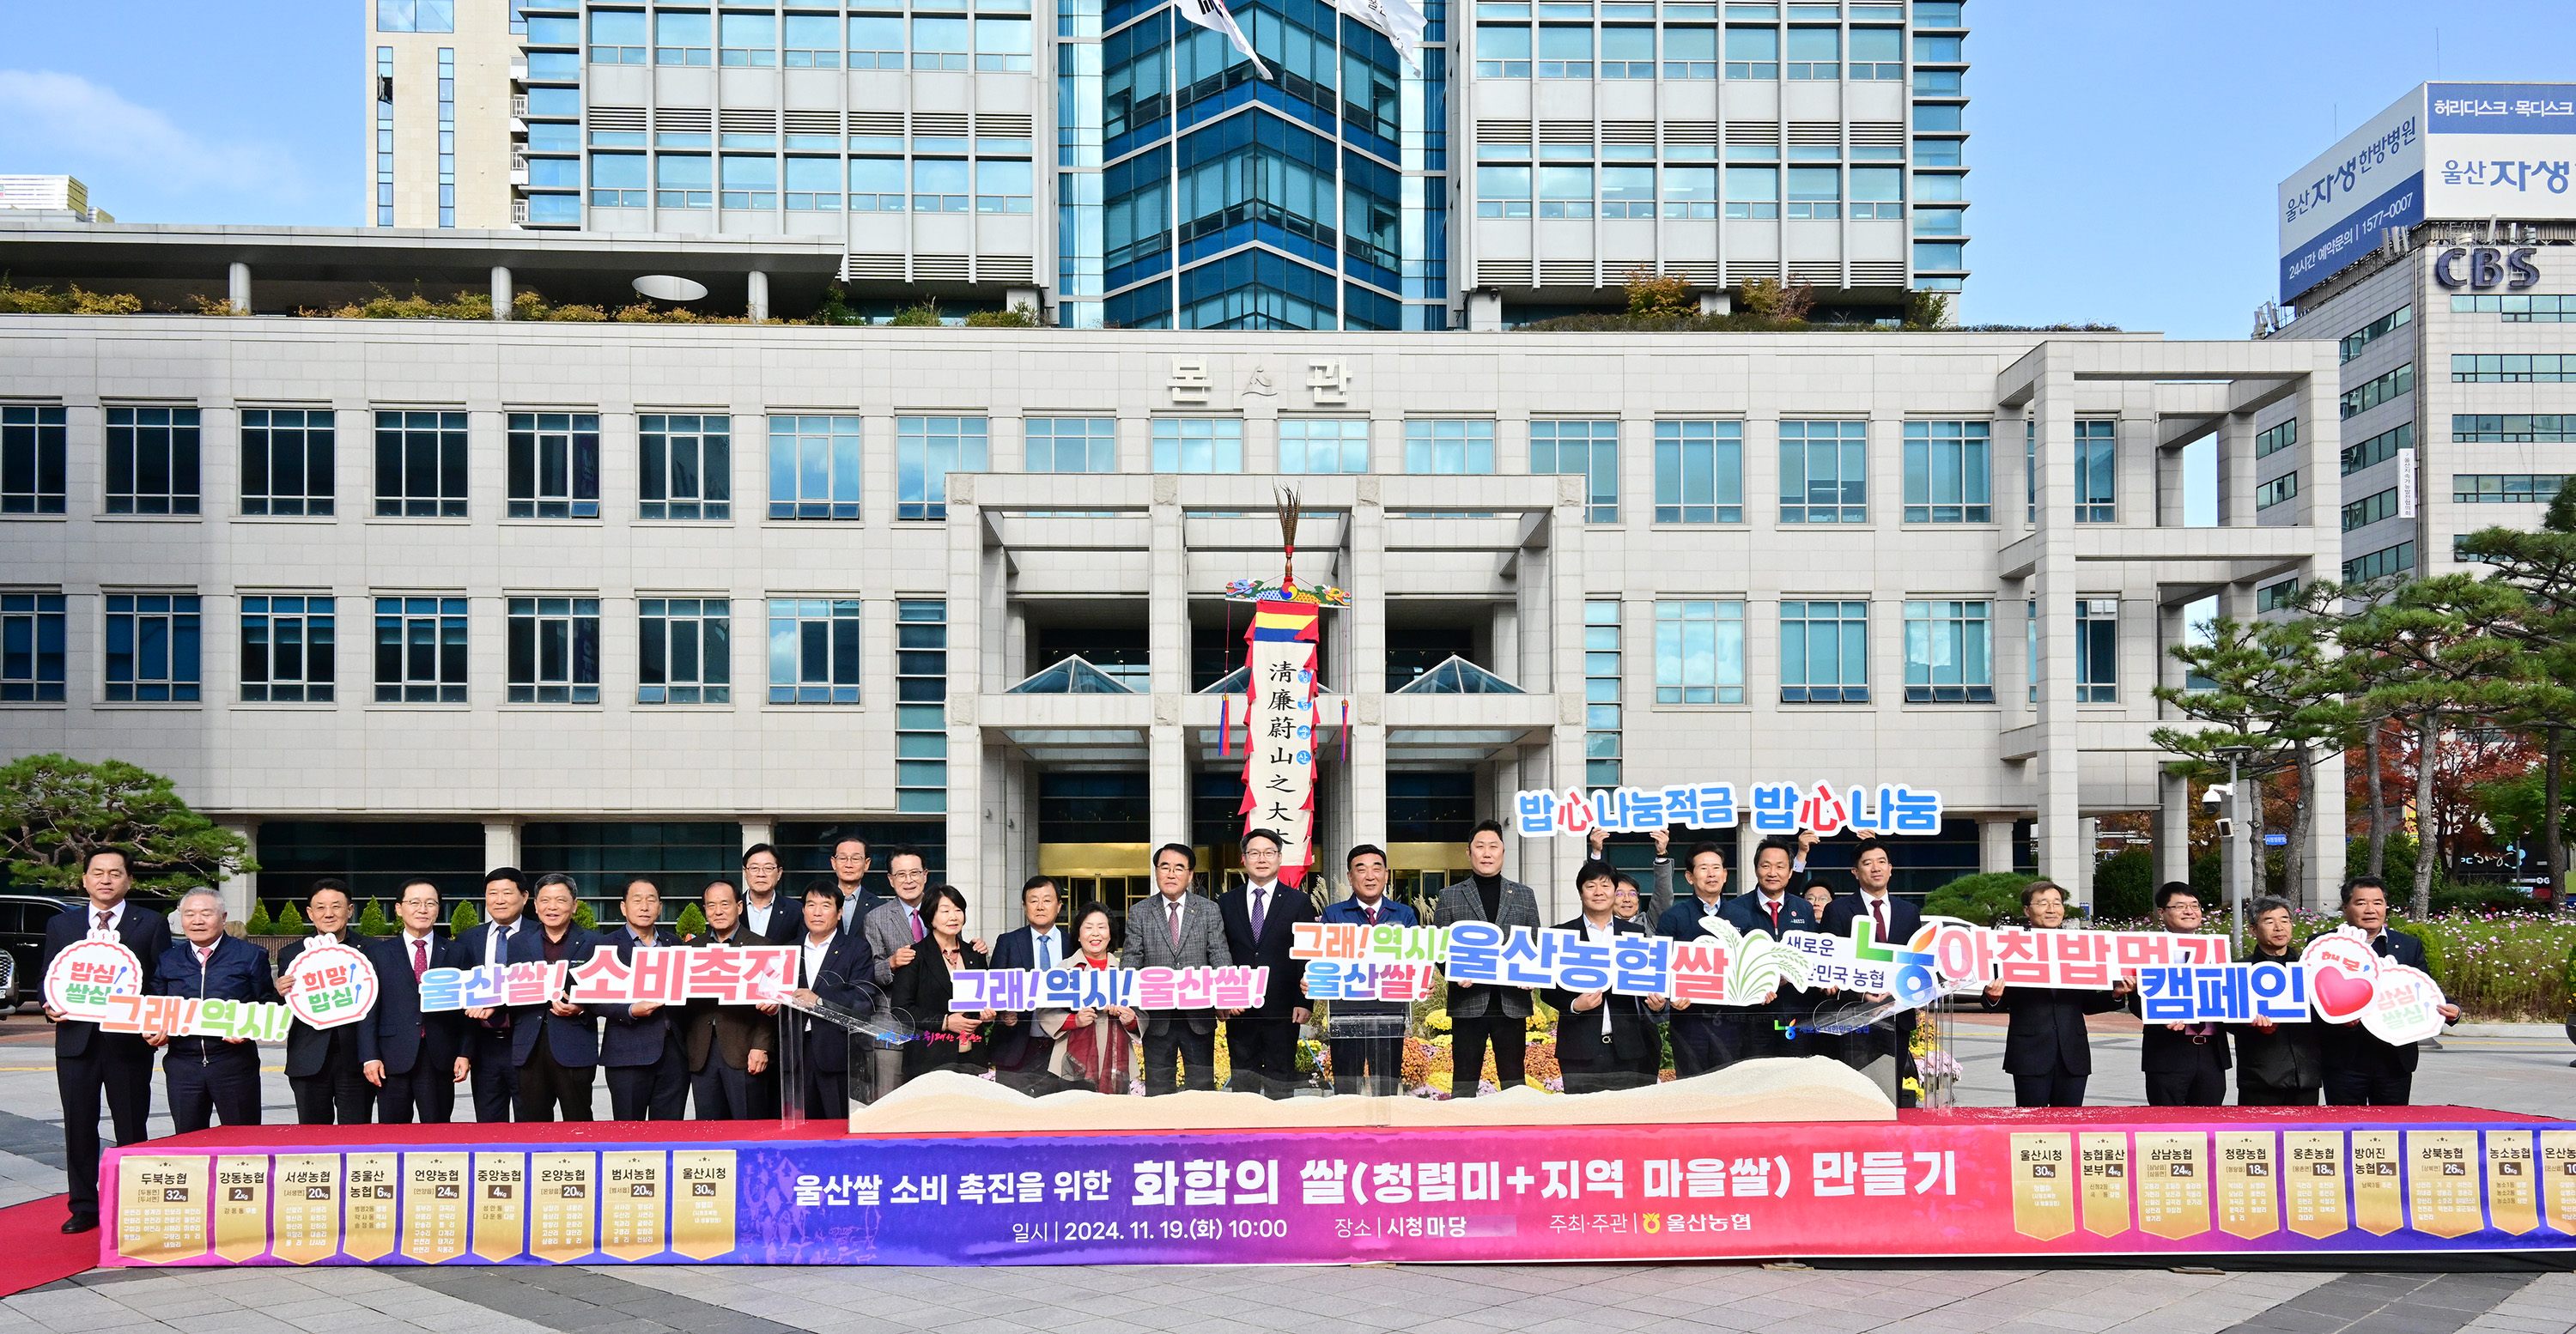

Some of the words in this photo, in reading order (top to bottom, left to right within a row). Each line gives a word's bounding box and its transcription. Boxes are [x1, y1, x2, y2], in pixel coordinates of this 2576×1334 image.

[2286, 190, 2310, 222] 울산
[2311, 155, 2356, 209] 자생
[2359, 116, 2416, 173] 한방병원
[2441, 161, 2486, 185] 울산
[2491, 161, 2569, 194] 자생
[2289, 258, 2316, 280] 24시간
[2318, 232, 2353, 261] 예약문의
[2438, 248, 2540, 289] CBS
[1167, 355, 1212, 402] 본
[1306, 356, 1352, 403] 관
[1291, 925, 1368, 959] 그래!
[1373, 925, 1449, 961] 역시!
[1787, 936, 1835, 957] 새로운
[70, 961, 116, 984] 밥심
[302, 965, 347, 991] 희망
[1853, 967, 1885, 988] 농협
[422, 961, 568, 1008] 울산쌀!
[1306, 961, 1432, 999] 울산쌀!
[65, 983, 112, 1005] 쌀심
[951, 970, 1041, 1011] 그래!
[1046, 969, 1133, 1009] 역시!
[1139, 967, 1268, 1009] 울산쌀!
[2141, 966, 2306, 1019] 캠페인
[308, 986, 354, 1013] 밥심
[102, 995, 196, 1035] 그래!
[202, 1003, 291, 1040] 역시!
[2020, 1150, 2063, 1161] 울산시청
[2083, 1149, 2125, 1161] 농협울산
[2151, 1149, 2193, 1160] 삼남농협
[2226, 1149, 2266, 1160] 청량농협
[2293, 1148, 2335, 1160] 웅촌농협
[2354, 1148, 2385, 1159] 방어진
[2422, 1148, 2464, 1159] 상북농협
[2490, 1148, 2530, 1159] 농소농협
[612, 1168, 655, 1180] 범서농협
[683, 1167, 726, 1179] 울산시청
[2083, 1165, 2104, 1176] 본부
[2355, 1163, 2375, 1174] 농협
[142, 1173, 186, 1185] 두북농협
[220, 1172, 264, 1184] 강동농협
[285, 1171, 330, 1183] 서생농협
[351, 1170, 385, 1182] 중울산
[415, 1170, 459, 1181] 언양농협
[478, 1170, 520, 1181] 중앙농협
[542, 1170, 585, 1181] 온양농협
[793, 1173, 882, 1206] 울산쌀
[890, 1173, 947, 1205] 소비
[957, 1171, 1045, 1204] 촉진을
[1054, 1170, 1111, 1201] 위한
[1132, 1159, 1279, 1206] 화합의
[1643, 1155, 1790, 1199] 마을쌀)
[1813, 1150, 1957, 1196] 만들기
[350, 1186, 372, 1198] 농협
[1012, 1222, 1048, 1243] 일시
[1064, 1222, 1124, 1241] 2024.
[1129, 1221, 1154, 1239] 11.
[1229, 1219, 1287, 1238] 10:00
[1334, 1218, 1372, 1238] 장소
[1667, 1213, 1752, 1233] 울산농협
